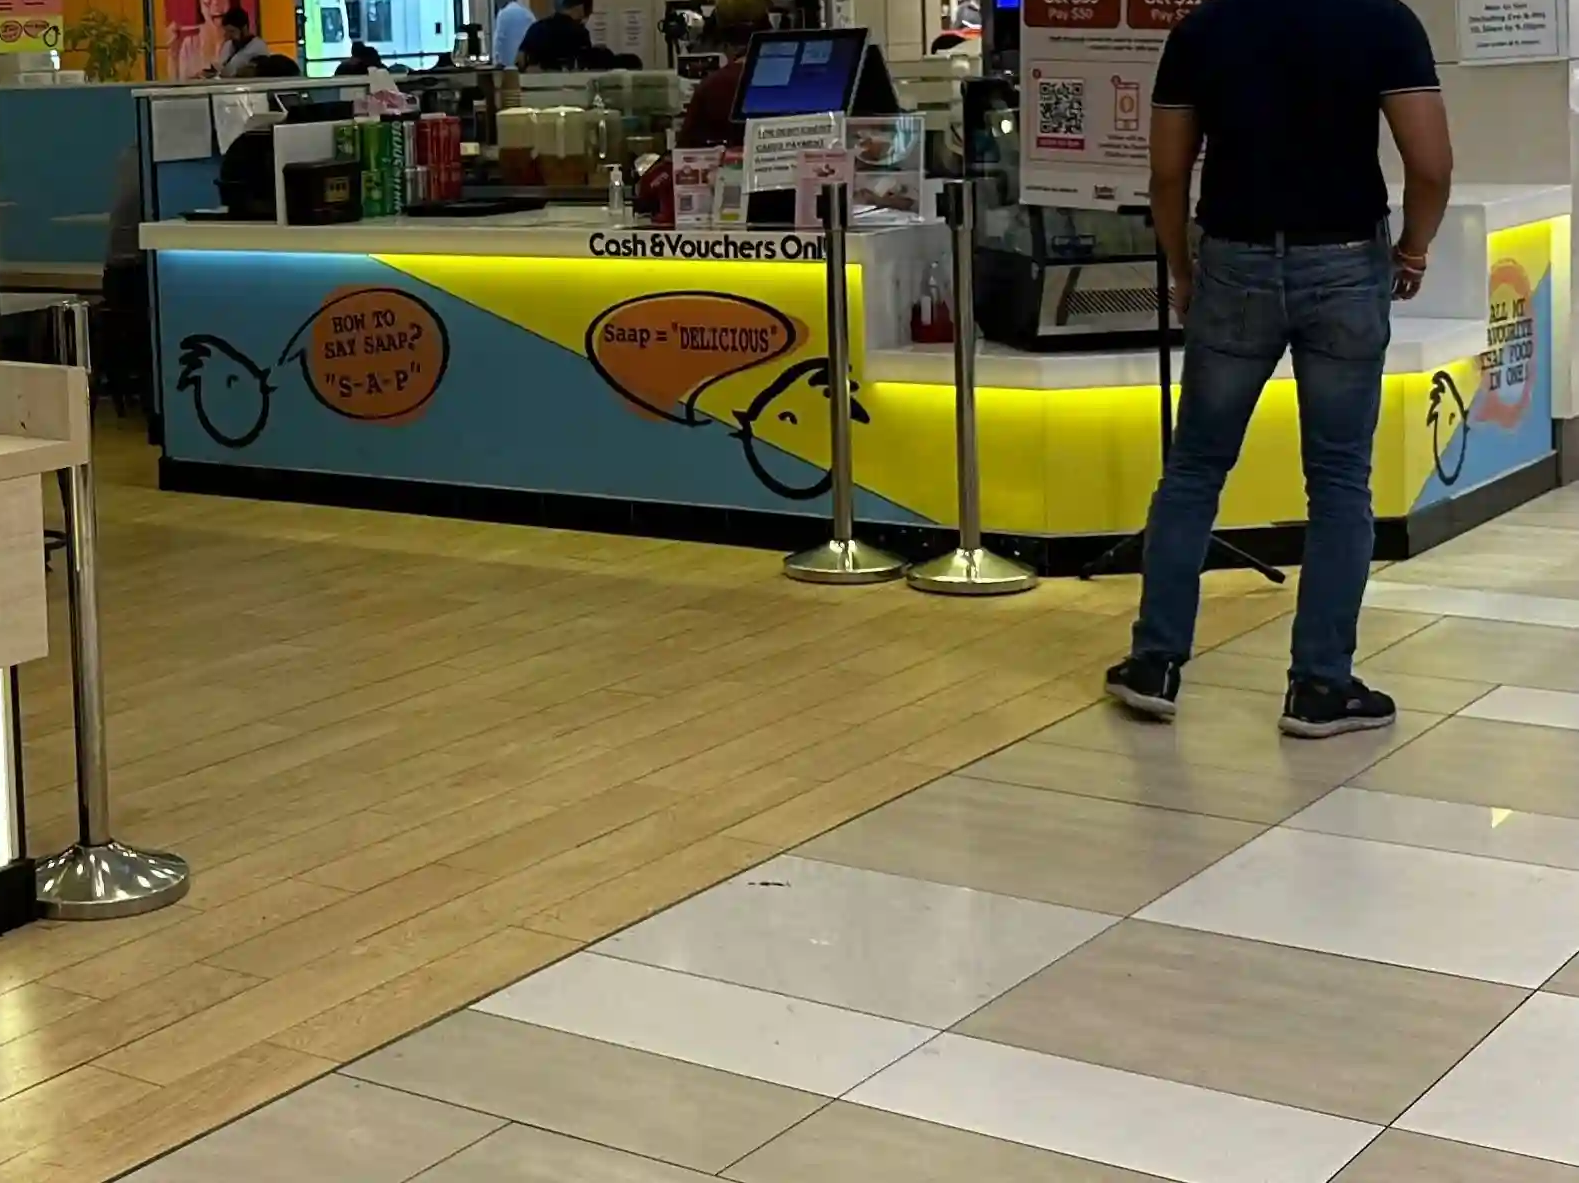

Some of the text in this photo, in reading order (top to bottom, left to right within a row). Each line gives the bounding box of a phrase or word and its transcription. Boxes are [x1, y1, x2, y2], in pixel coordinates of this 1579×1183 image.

[589, 233, 646, 257] Cash
[332, 310, 395, 334] HOW TO
[1490, 298, 1526, 323] ALL MY
[324, 322, 423, 360] SAY SAAP?
[604, 323, 651, 349] Saap
[671, 322, 778, 353] "DELICIOUS"
[1487, 319, 1533, 346] AVOURITE
[1510, 340, 1533, 361] FOOD
